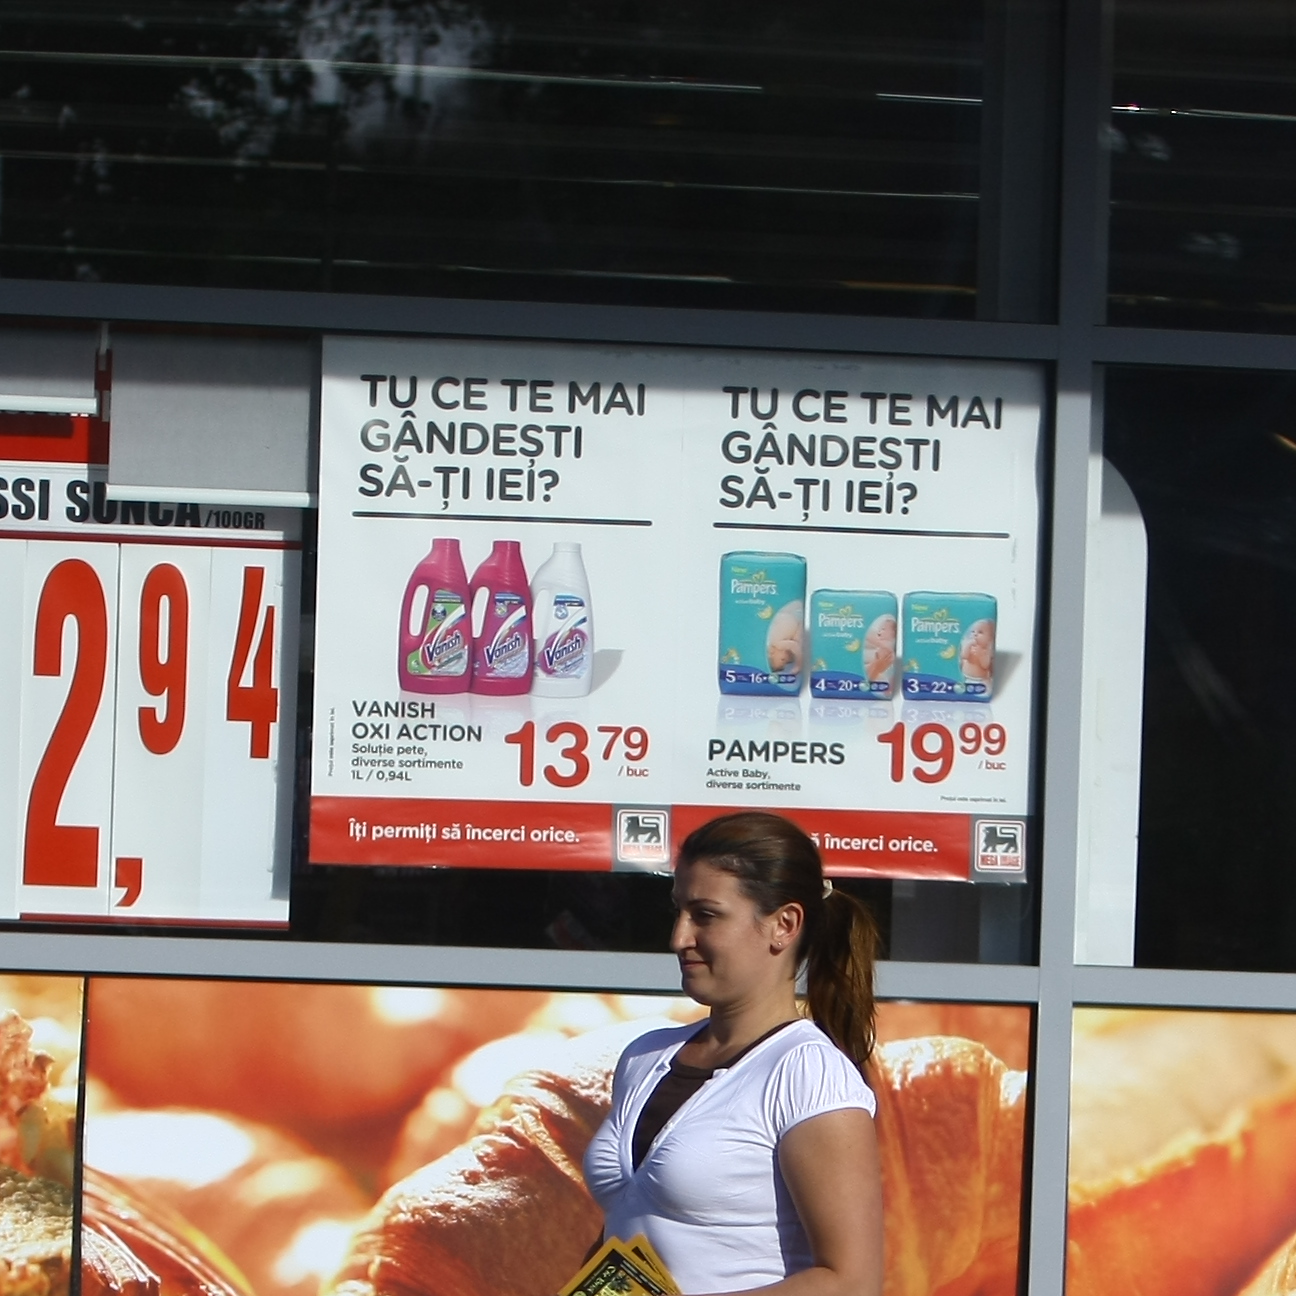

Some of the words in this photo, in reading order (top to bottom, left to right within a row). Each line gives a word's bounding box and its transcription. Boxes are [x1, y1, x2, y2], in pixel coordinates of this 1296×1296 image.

[360, 374, 418, 409] TU
[431, 376, 488, 411] CE
[502, 379, 554, 414] TE
[569, 381, 646, 417] MAI
[723, 385, 777, 421] TU
[791, 388, 847, 424] CE
[860, 392, 912, 427] TE
[926, 394, 1002, 429] MAI
[360, 411, 583, 466] GÂNDEȘTI
[721, 423, 941, 480] GÂNDEȘTI
[359, 457, 470, 510] SĂ-ȚI
[487, 468, 560, 503] IEI?
[720, 467, 830, 521] SĂ-ȚI
[845, 480, 918, 516] IEI?
[731, 579, 777, 595] Pampers
[818, 614, 863, 629] Pampers
[911, 617, 960, 634] Pampers
[426, 633, 461, 663] Vanish
[486, 636, 521, 664] Vanish
[546, 637, 581, 667] Vanish
[726, 670, 736, 683] 5
[750, 673, 762, 683] 16
[815, 679, 825, 692] 4
[839, 681, 853, 691] 20
[907, 679, 919, 693] 3
[932, 682, 946, 693] 22
[353, 701, 435, 719] VANISH
[352, 722, 393, 741] OXI
[397, 723, 482, 742] ACTION
[397, 745, 428, 760] pete,
[504, 721, 590, 788] 13
[597, 725, 648, 761] 79
[708, 738, 845, 765] PAMPERS
[877, 722, 955, 783] 19
[959, 723, 1006, 756] 99
[352, 757, 396, 769] diverse
[399, 758, 464, 770] sortimente
[351, 770, 363, 781] 1L
[376, 770, 412, 783] 0,94L
[706, 779, 742, 790] diverse
[745, 780, 802, 792] sortimente
[707, 768, 738, 779] Active
[741, 769, 771, 783] Baby,
[372, 822, 437, 844] permiți
[441, 823, 462, 841] să
[465, 823, 525, 843] încerci
[530, 826, 580, 844] orice.
[824, 833, 884, 850] încerci
[888, 836, 938, 852] orice.
